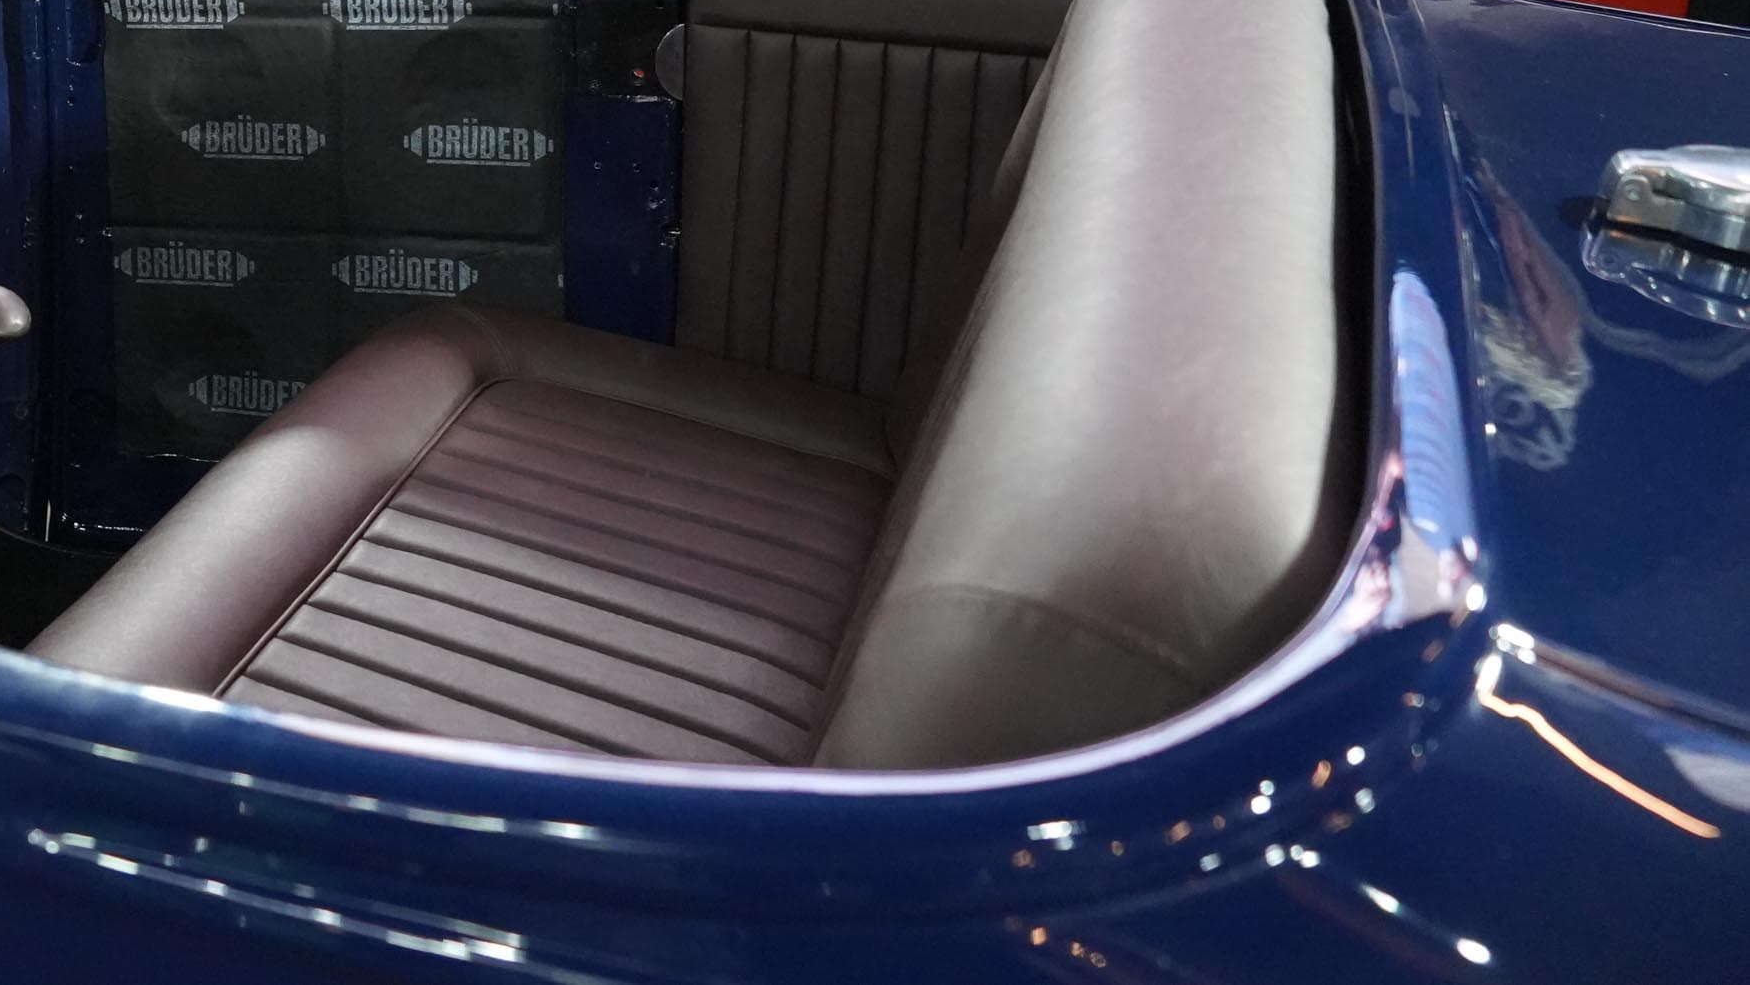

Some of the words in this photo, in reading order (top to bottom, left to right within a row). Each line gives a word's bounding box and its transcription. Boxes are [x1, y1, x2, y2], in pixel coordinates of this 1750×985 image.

[204, 114, 303, 155] BRÜDER
[426, 118, 530, 161] BRÜDER
[136, 241, 233, 281] BRÜDER
[354, 248, 455, 292] BRÜDER
